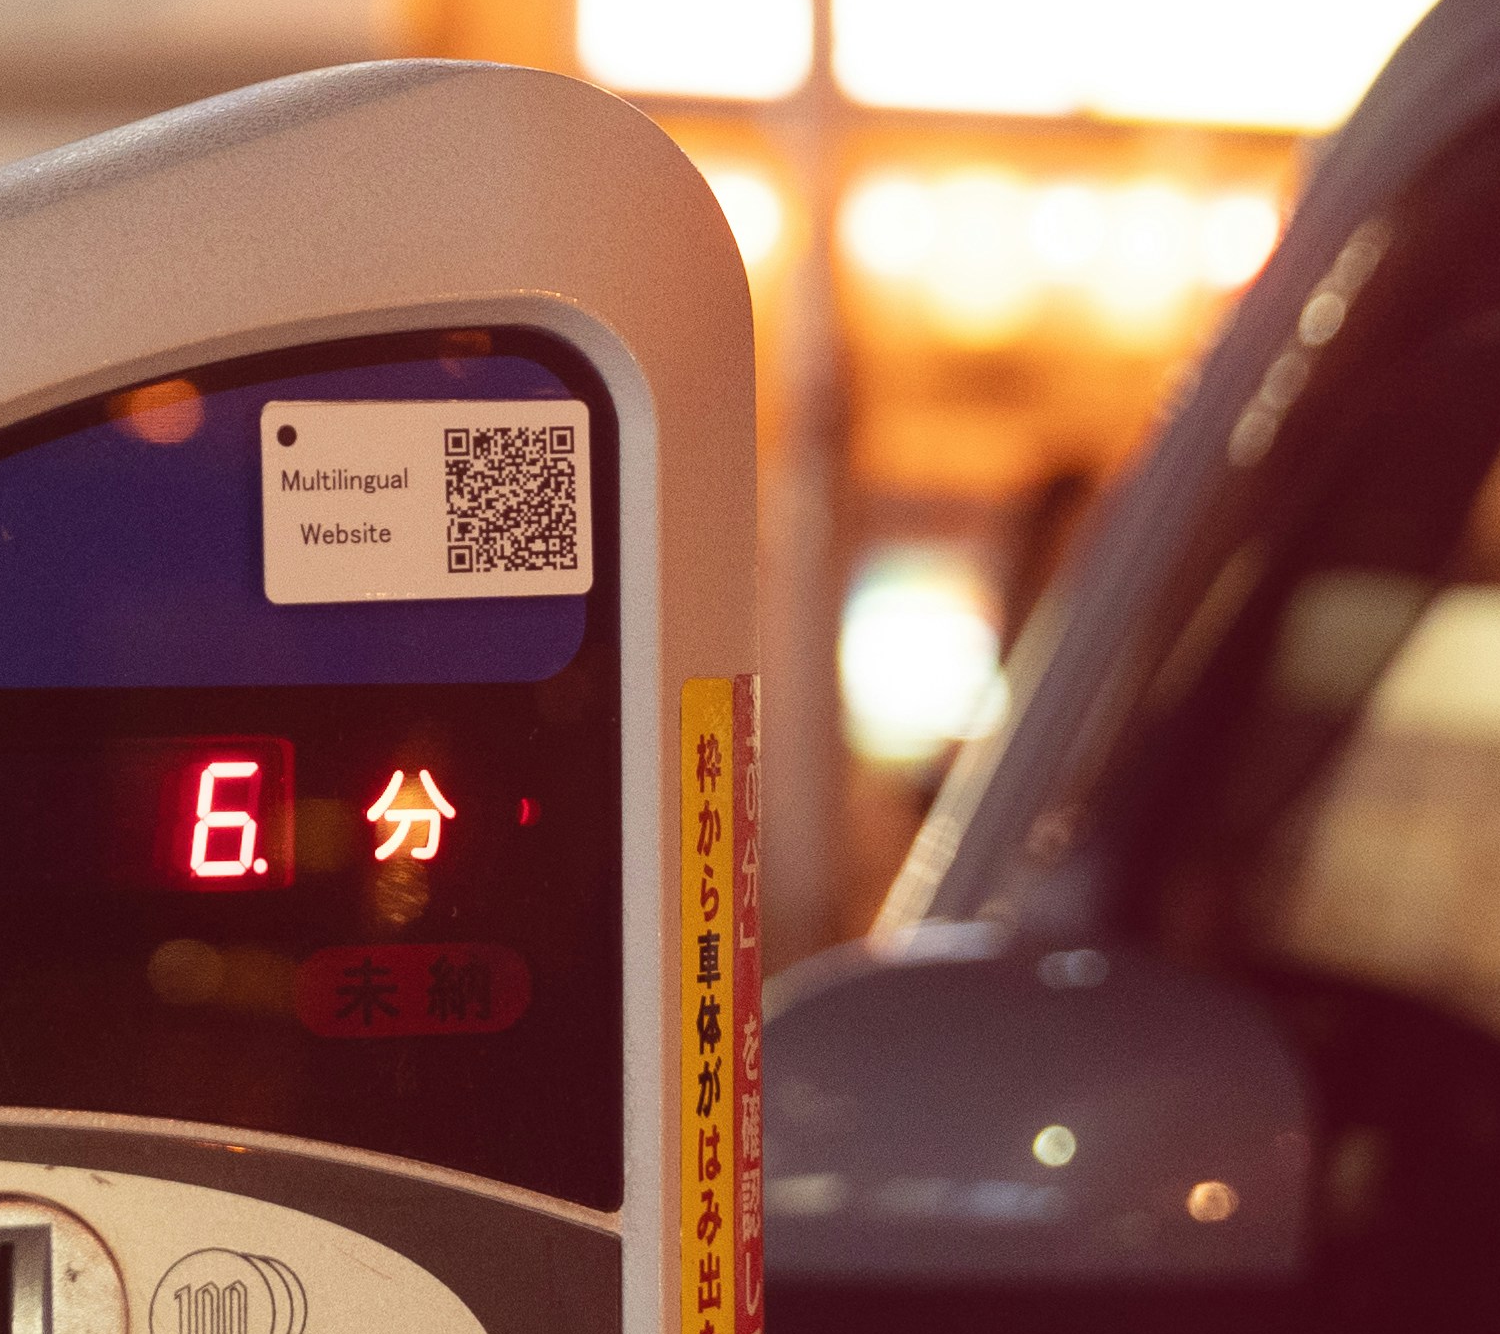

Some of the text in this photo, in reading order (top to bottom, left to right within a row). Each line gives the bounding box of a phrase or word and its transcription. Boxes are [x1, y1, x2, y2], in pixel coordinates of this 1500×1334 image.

[281, 468, 410, 494] Multilingual
[300, 521, 393, 546] Website
[364, 769, 457, 861] 分
[333, 953, 493, 1023] 未納
